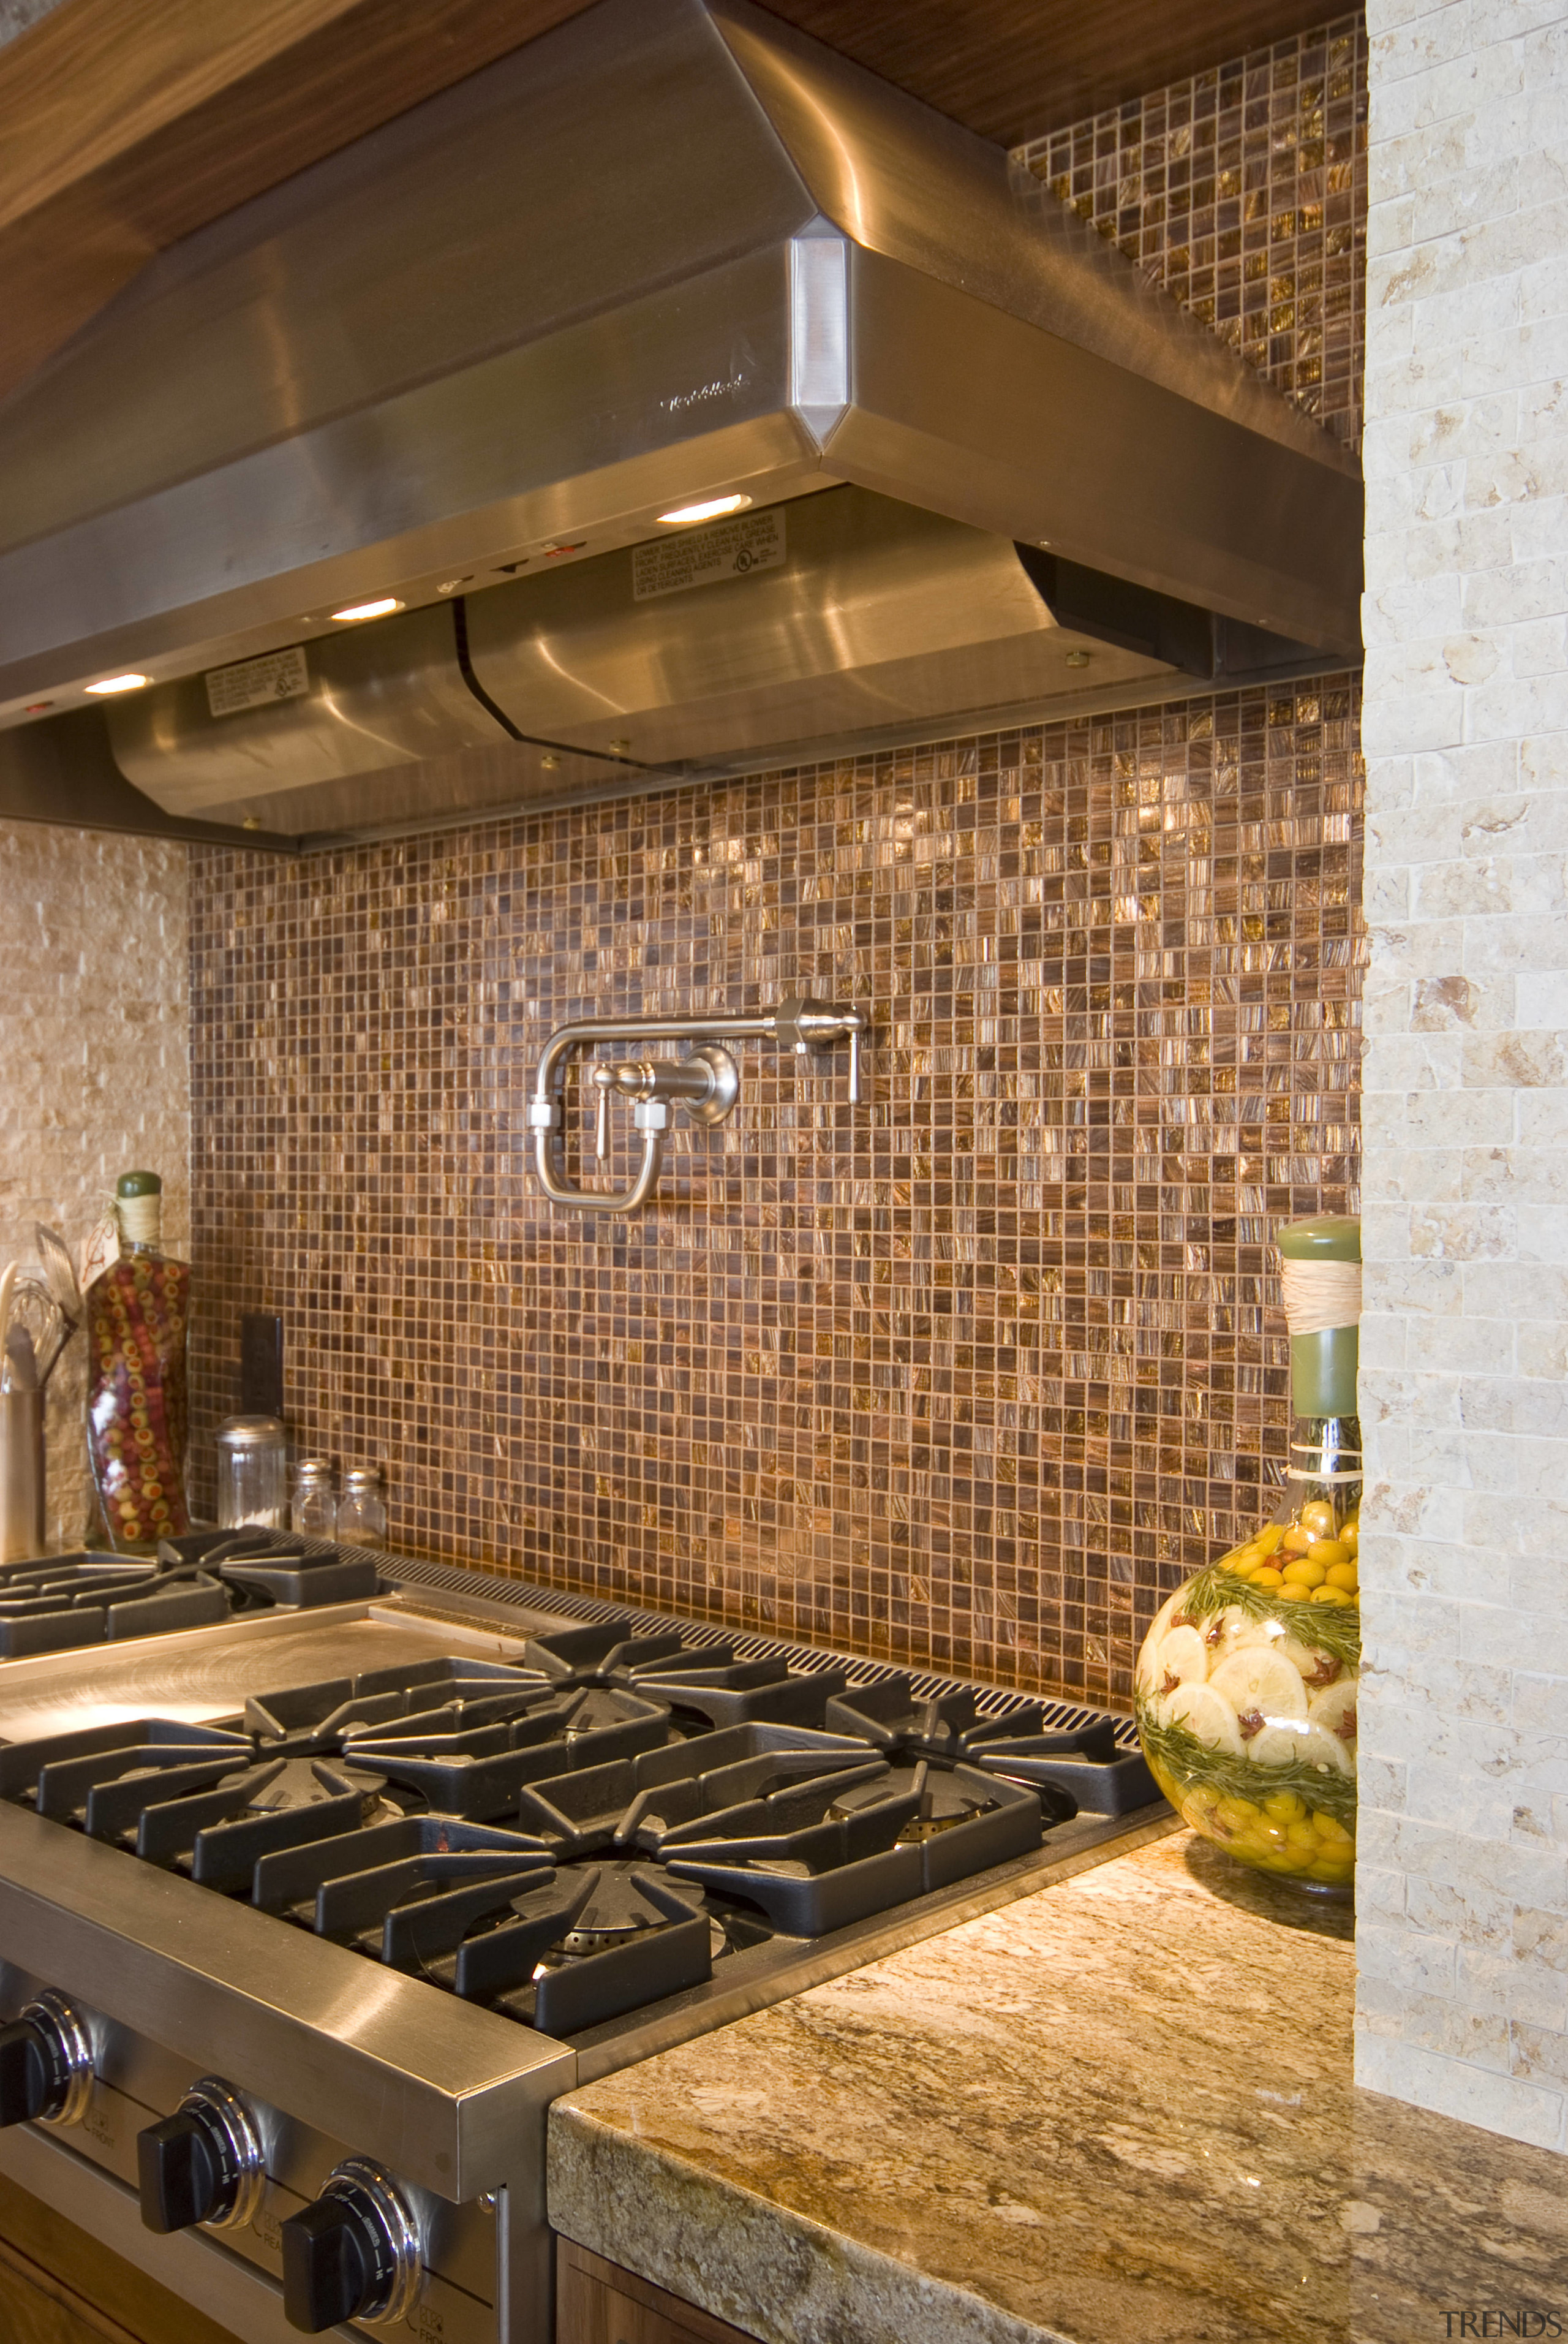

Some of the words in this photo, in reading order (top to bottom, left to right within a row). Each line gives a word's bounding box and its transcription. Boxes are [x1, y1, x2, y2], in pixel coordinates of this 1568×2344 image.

[635, 545, 660, 559] LOWER
[661, 540, 676, 551] THIS
[678, 533, 702, 547] SHIELD
[710, 523, 739, 539] REMOVE
[741, 514, 773, 530] BLOWER
[660, 542, 704, 561] FREQUENTLY
[707, 535, 729, 549] CLEAN
[731, 532, 744, 542] ALL
[745, 523, 775, 539] GREASE
[636, 564, 657, 577] LADEN
[734, 539, 754, 551] CARE
[756, 532, 778, 545] WHEN
[636, 573, 657, 586] USING
[658, 564, 692, 580] CLEANING
[693, 557, 721, 571] AGENTS
[637, 586, 646, 595] OR
[222, 2174, 230, 2185] HI
[334, 2193, 350, 2202] OFF
[264, 2233, 281, 2252] REA
[361, 2216, 380, 2248] SIMMER
[375, 2269, 383, 2280] HI
